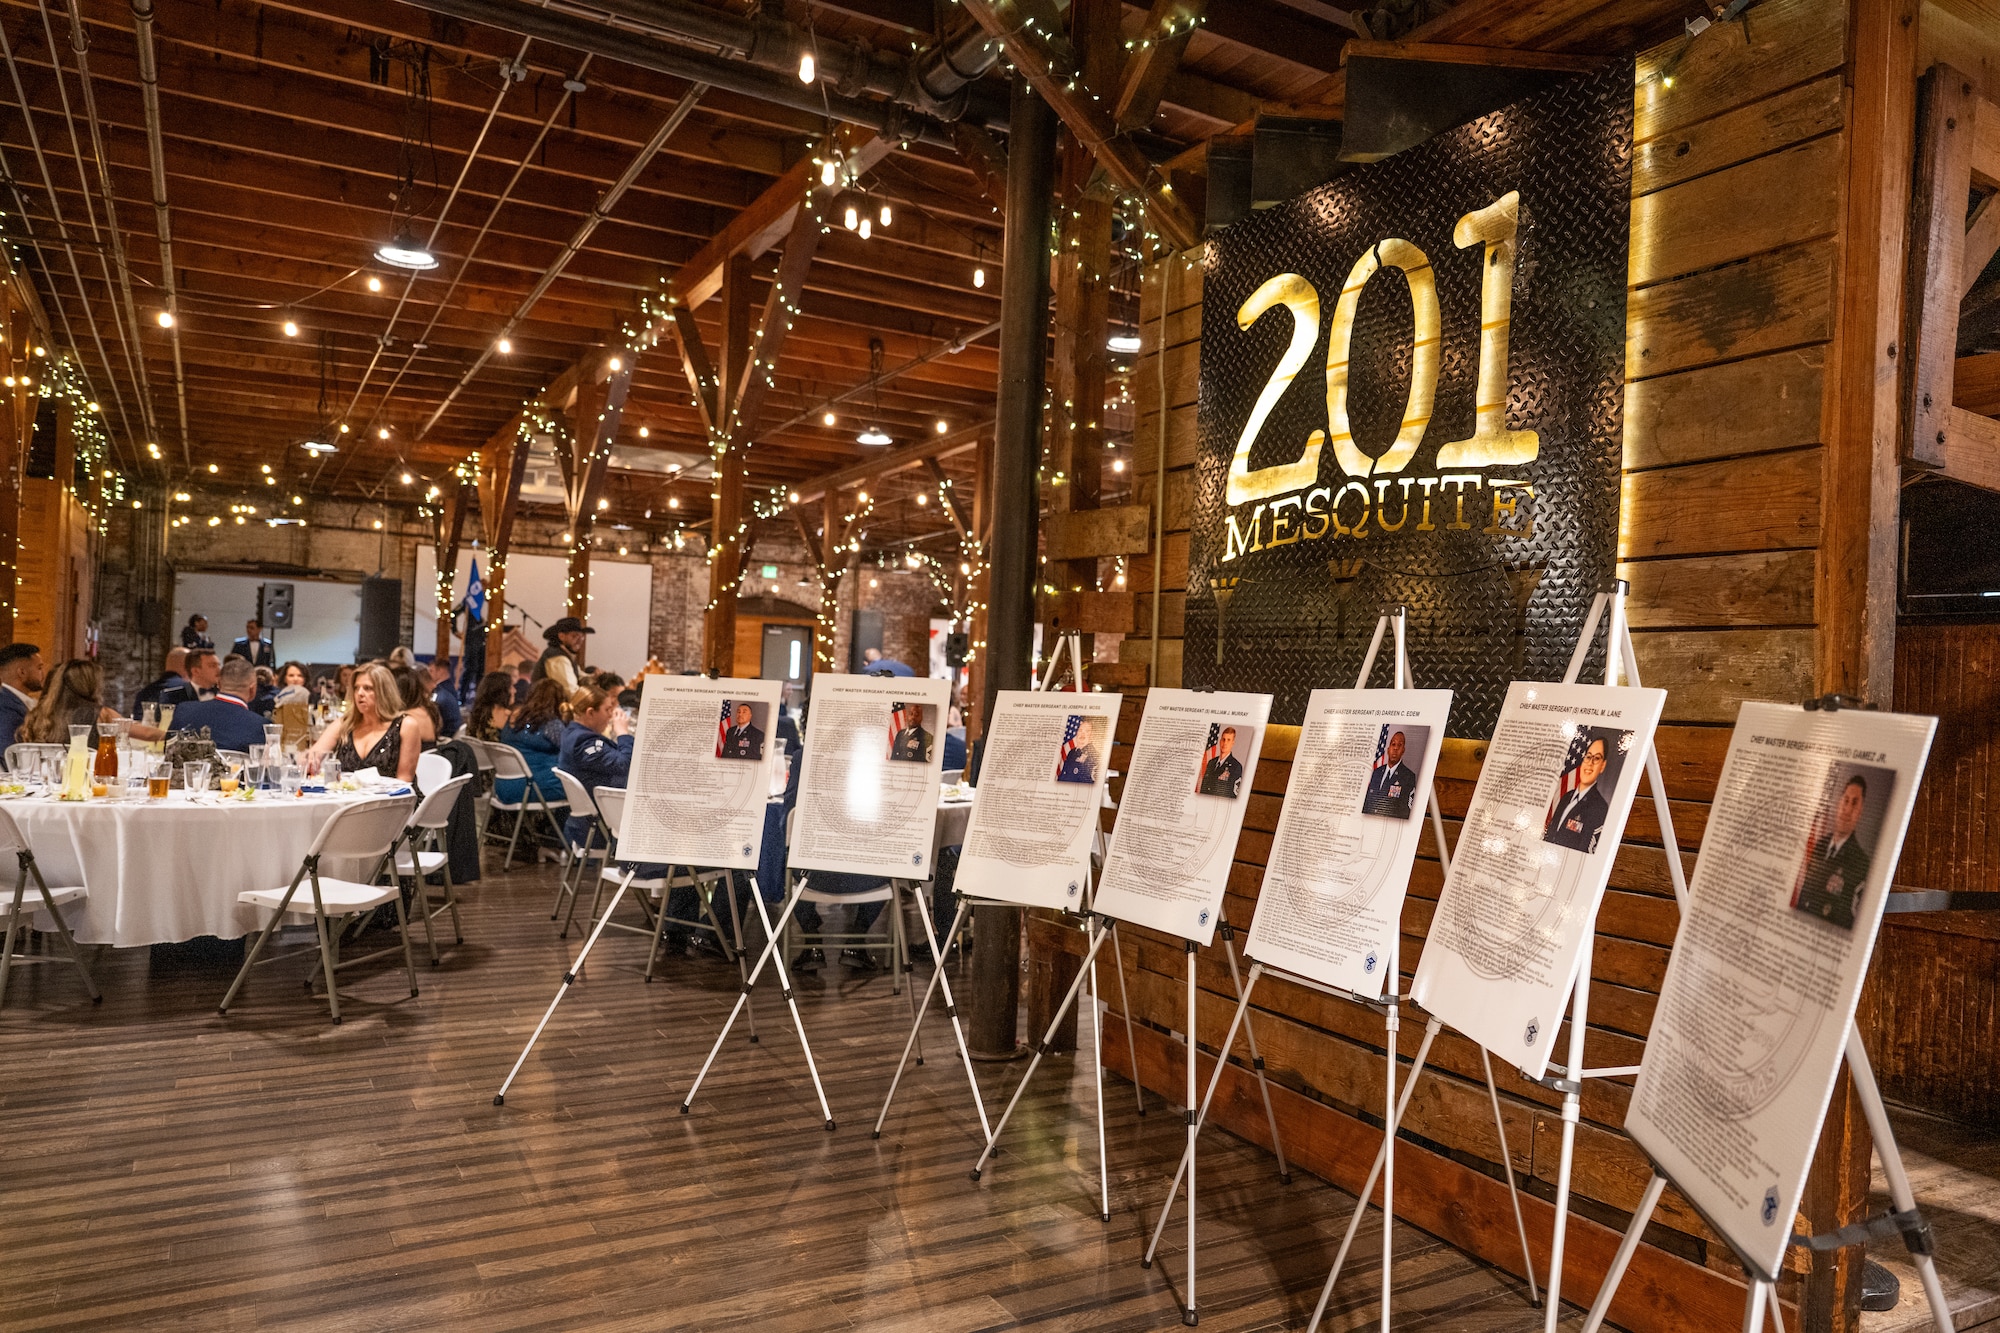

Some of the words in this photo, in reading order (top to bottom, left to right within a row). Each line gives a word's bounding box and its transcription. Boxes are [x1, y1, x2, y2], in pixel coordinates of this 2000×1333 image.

[1227, 190, 1540, 506] 201
[1221, 474, 1535, 563] MESQUITE
[1548, 704, 1573, 713] SERGEANT
[1579, 707, 1599, 716] KRISTAL
[1750, 735, 1765, 744] CHIEF
[1765, 737, 1787, 748] MASTER
[1852, 749, 1876, 762] GAMEZ
[1877, 752, 1887, 763] JR.
